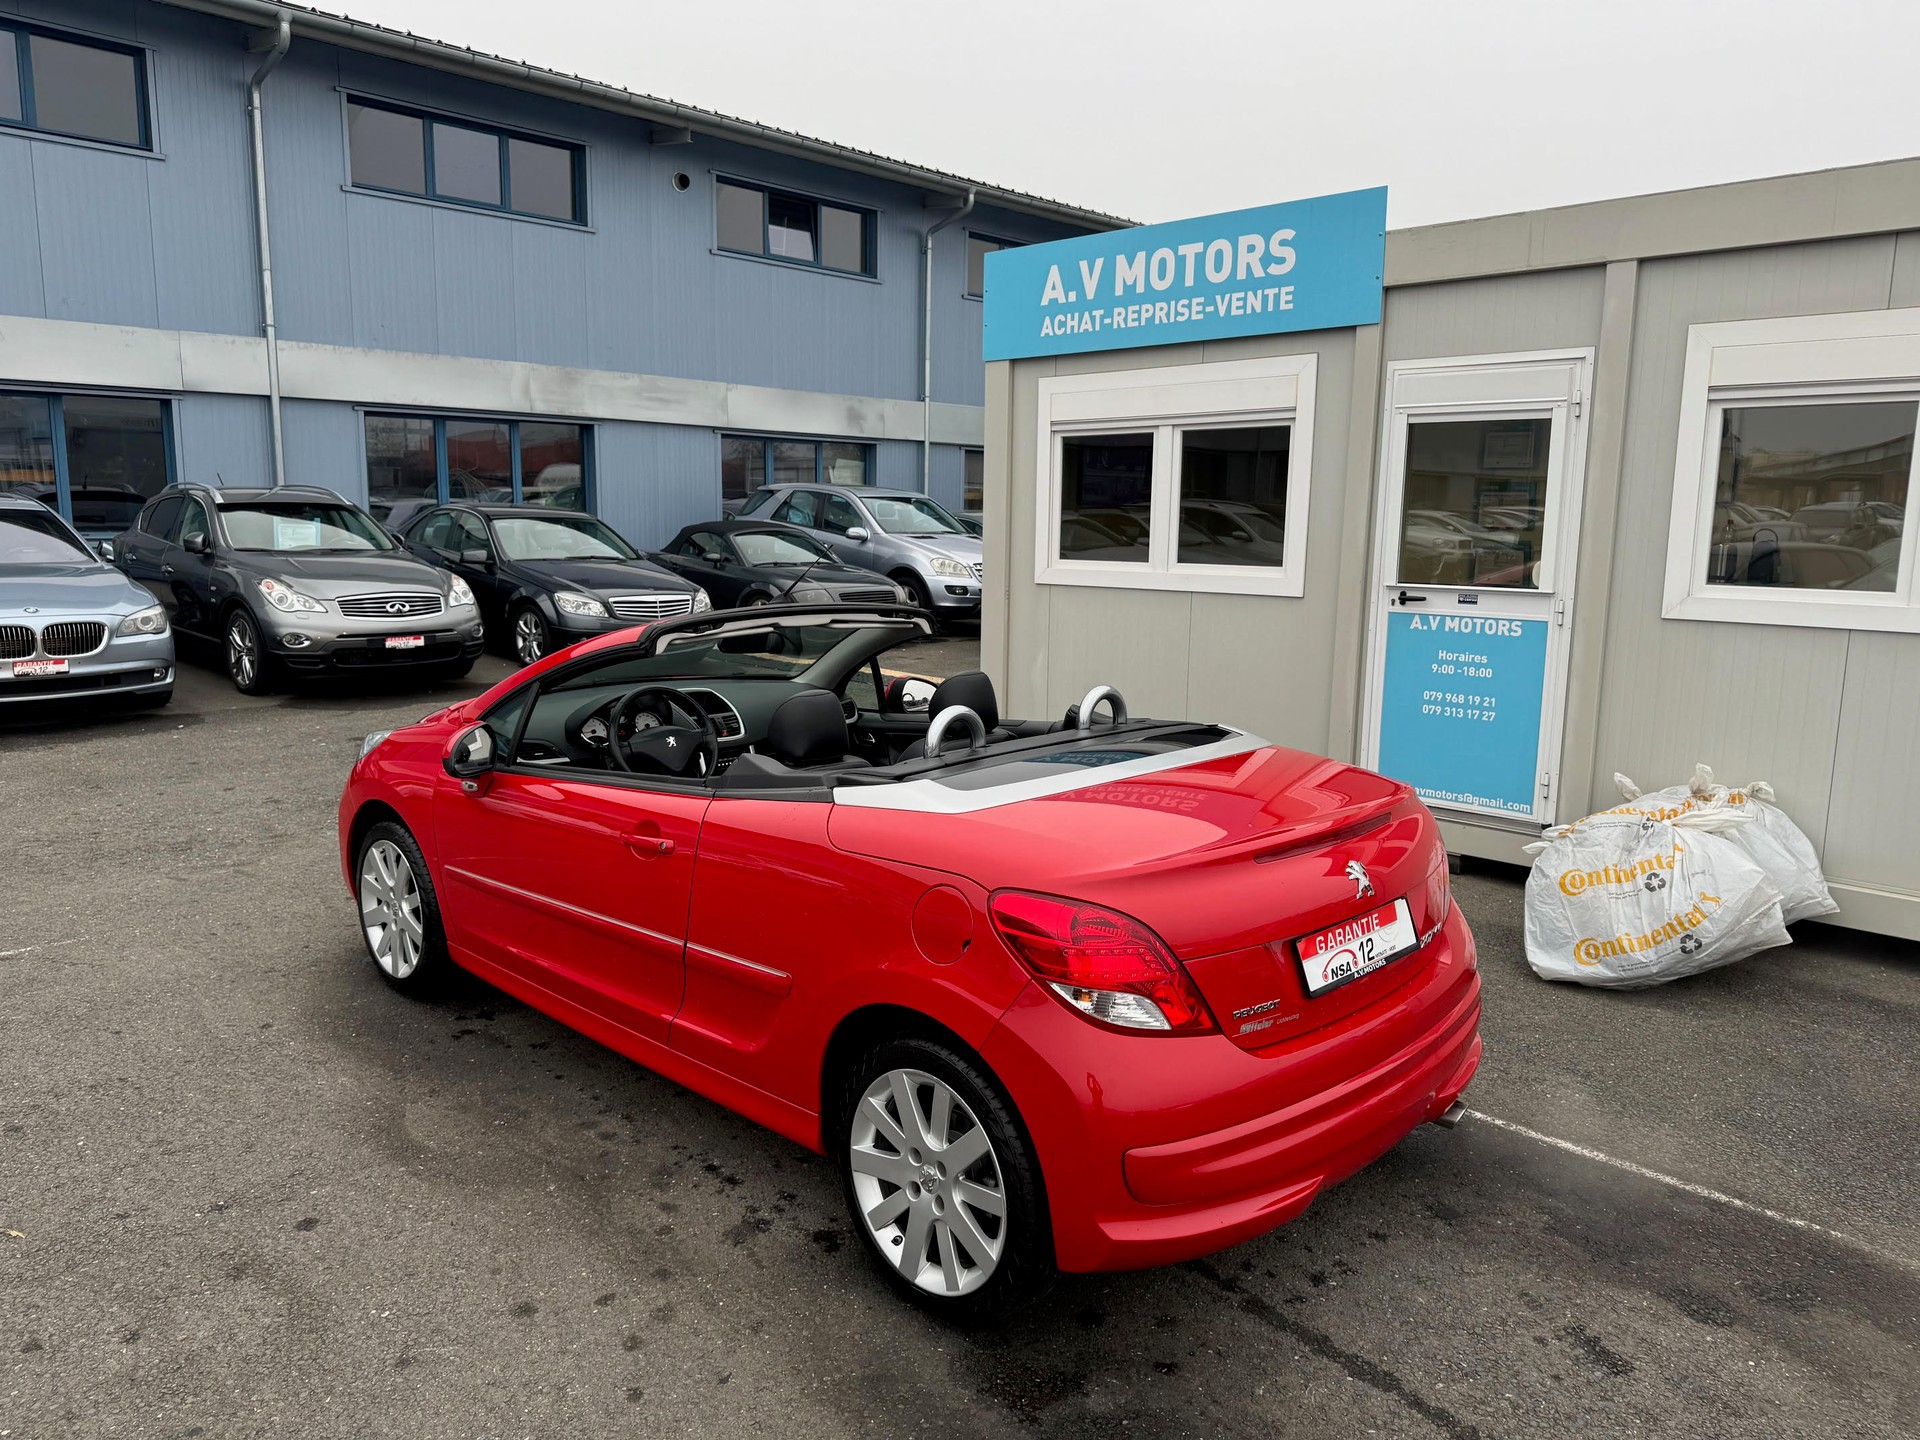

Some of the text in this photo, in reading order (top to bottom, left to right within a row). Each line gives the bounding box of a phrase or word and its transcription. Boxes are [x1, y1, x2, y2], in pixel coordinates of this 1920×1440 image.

[1040, 228, 1297, 306] A.V MOTORS
[1040, 286, 1295, 337] ACHAT-REPRISE-VENTE
[1409, 614, 1522, 637] A.V MOTORS
[1438, 649, 1488, 664] Horaires
[1431, 663, 1455, 675] 9:00
[1423, 690, 1496, 707] 079 968 19 21
[1422, 704, 1496, 722] 079 313 17 27
[1559, 853, 1675, 897] Continenta
[1315, 913, 1380, 954] GARANTIE
[1574, 902, 1708, 967] Continental
[1358, 937, 1375, 965] 12
[1331, 961, 1352, 980] NSA
[1354, 959, 1387, 979] A.V.MOTORS
[1232, 998, 1281, 1020] PEUGEOT
